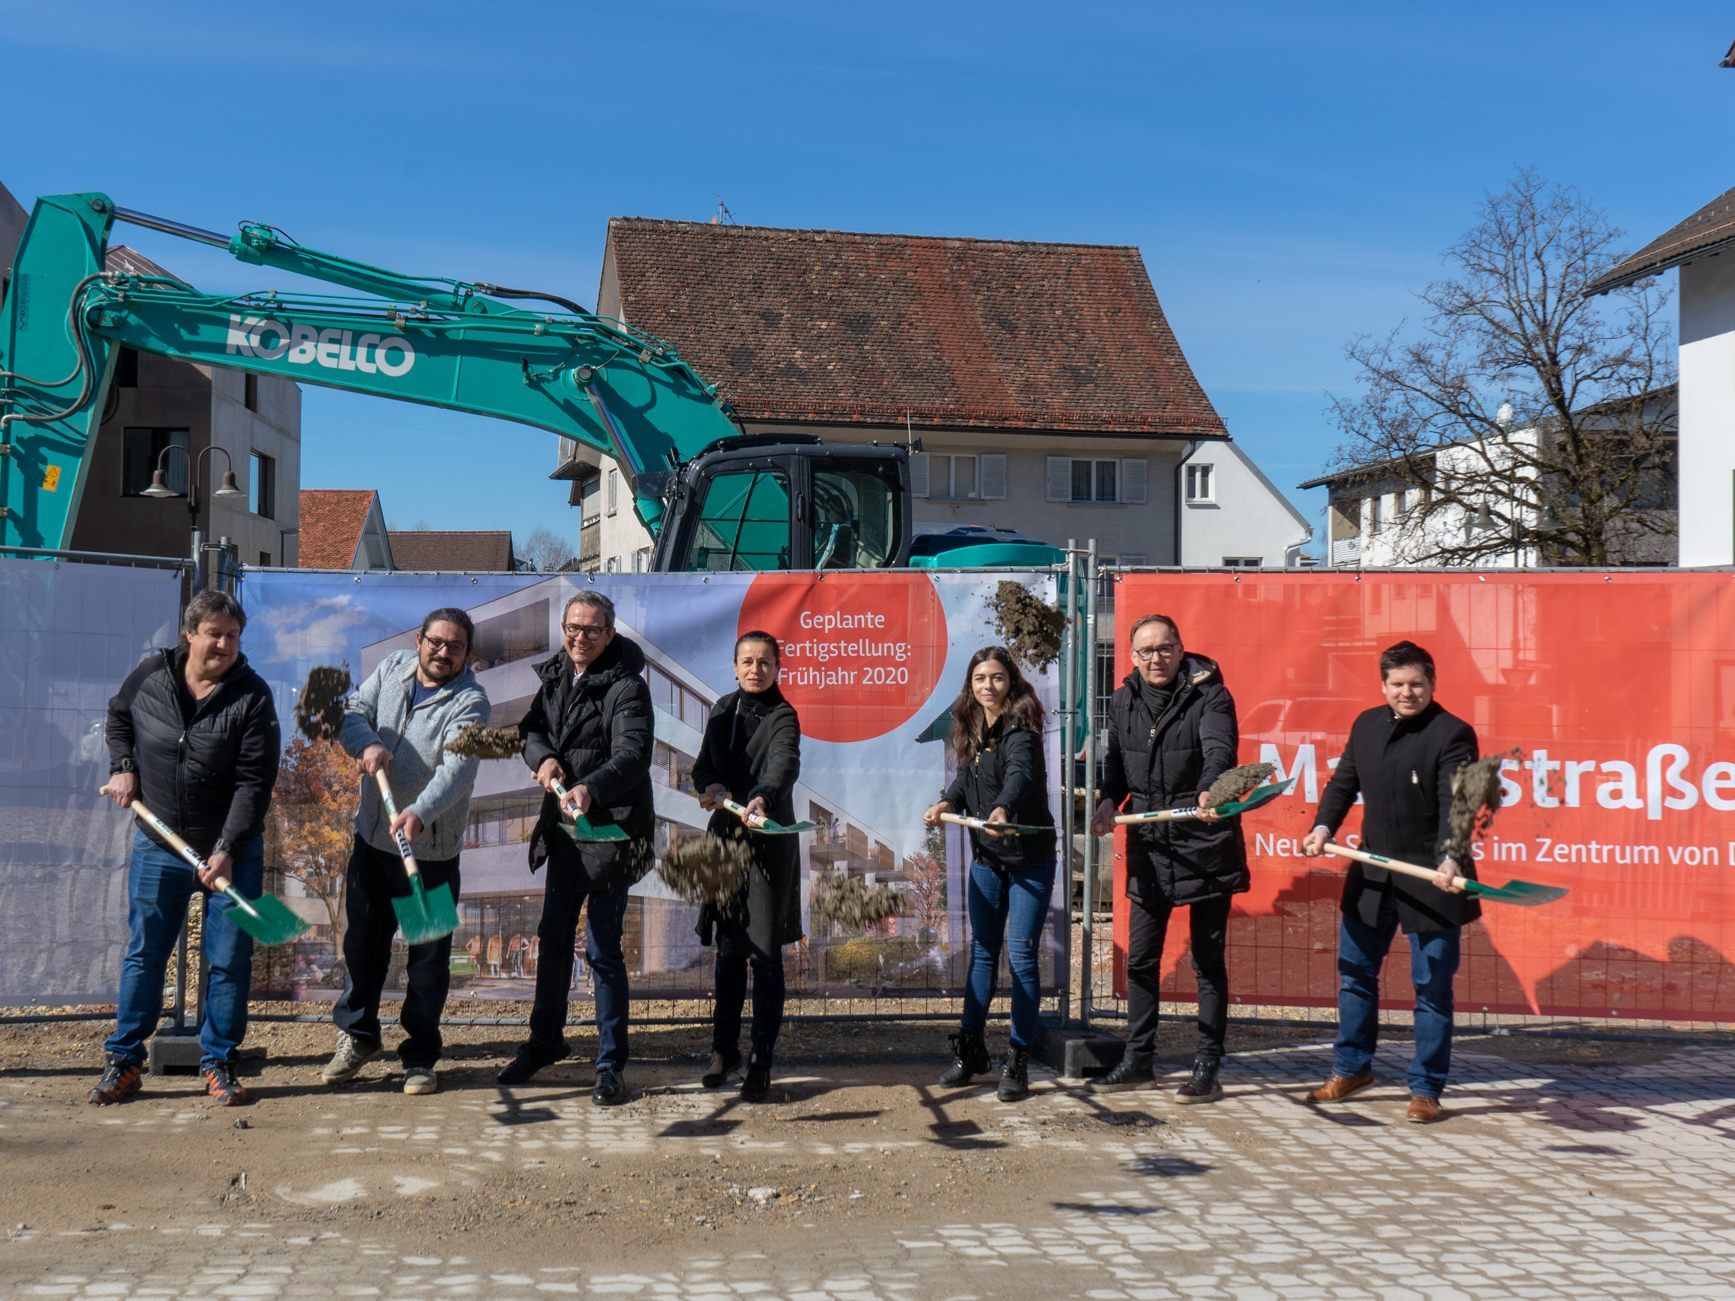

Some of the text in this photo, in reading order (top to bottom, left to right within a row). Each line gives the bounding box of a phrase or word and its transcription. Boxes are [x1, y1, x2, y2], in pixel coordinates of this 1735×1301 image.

[226, 313, 416, 377] KOBELCO
[800, 610, 886, 633] Geplante
[777, 666, 909, 689] Frühjahr 2020
[1493, 835, 1527, 862] im
[1535, 837, 1660, 864] Zentrum
[1668, 845, 1719, 866] von
